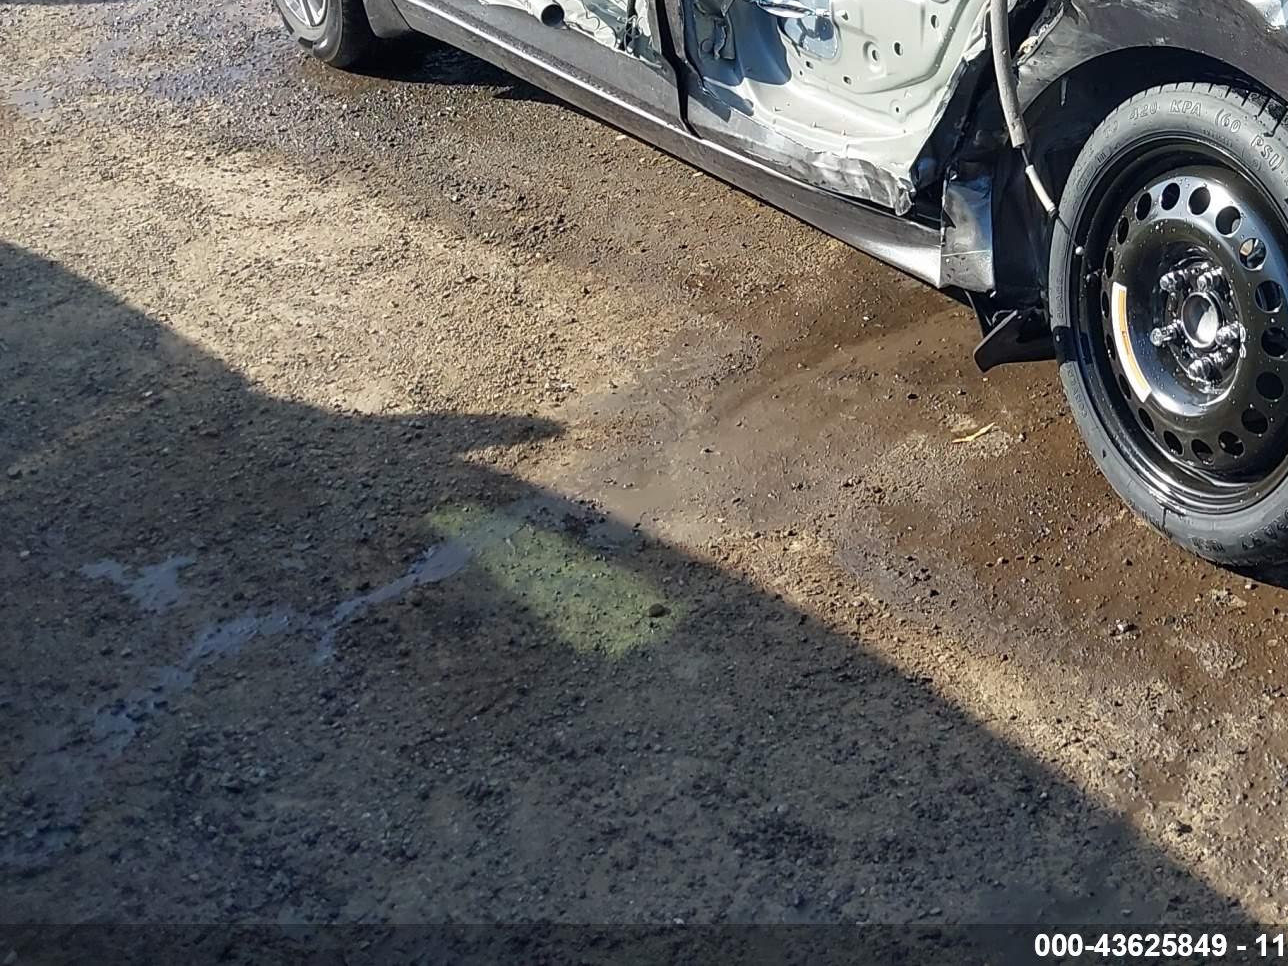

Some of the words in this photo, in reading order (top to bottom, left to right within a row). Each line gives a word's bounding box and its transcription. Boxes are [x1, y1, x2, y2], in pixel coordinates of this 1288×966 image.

[1128, 100, 1157, 120] 420
[1170, 99, 1203, 117] KPA
[1214, 108, 1242, 133] (60
[1250, 135, 1285, 172] PSI)
